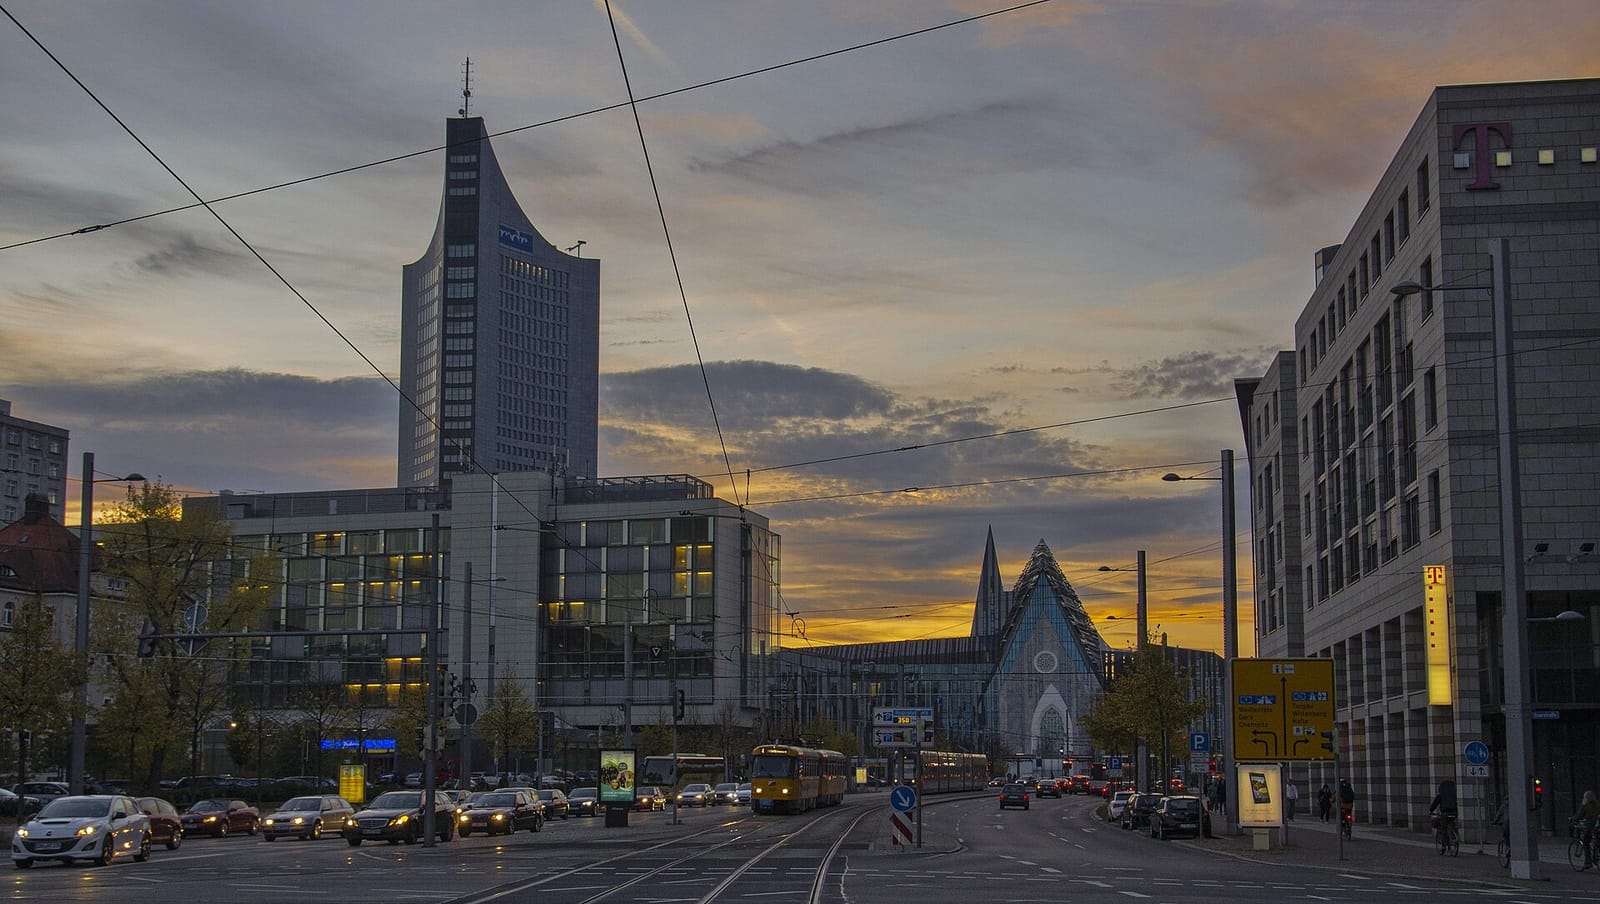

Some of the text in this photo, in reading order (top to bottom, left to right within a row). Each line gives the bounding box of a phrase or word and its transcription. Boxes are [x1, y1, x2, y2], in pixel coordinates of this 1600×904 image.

[1453, 123, 1511, 191] T
[1427, 567, 1442, 584] T
[1194, 735, 1205, 749] P
